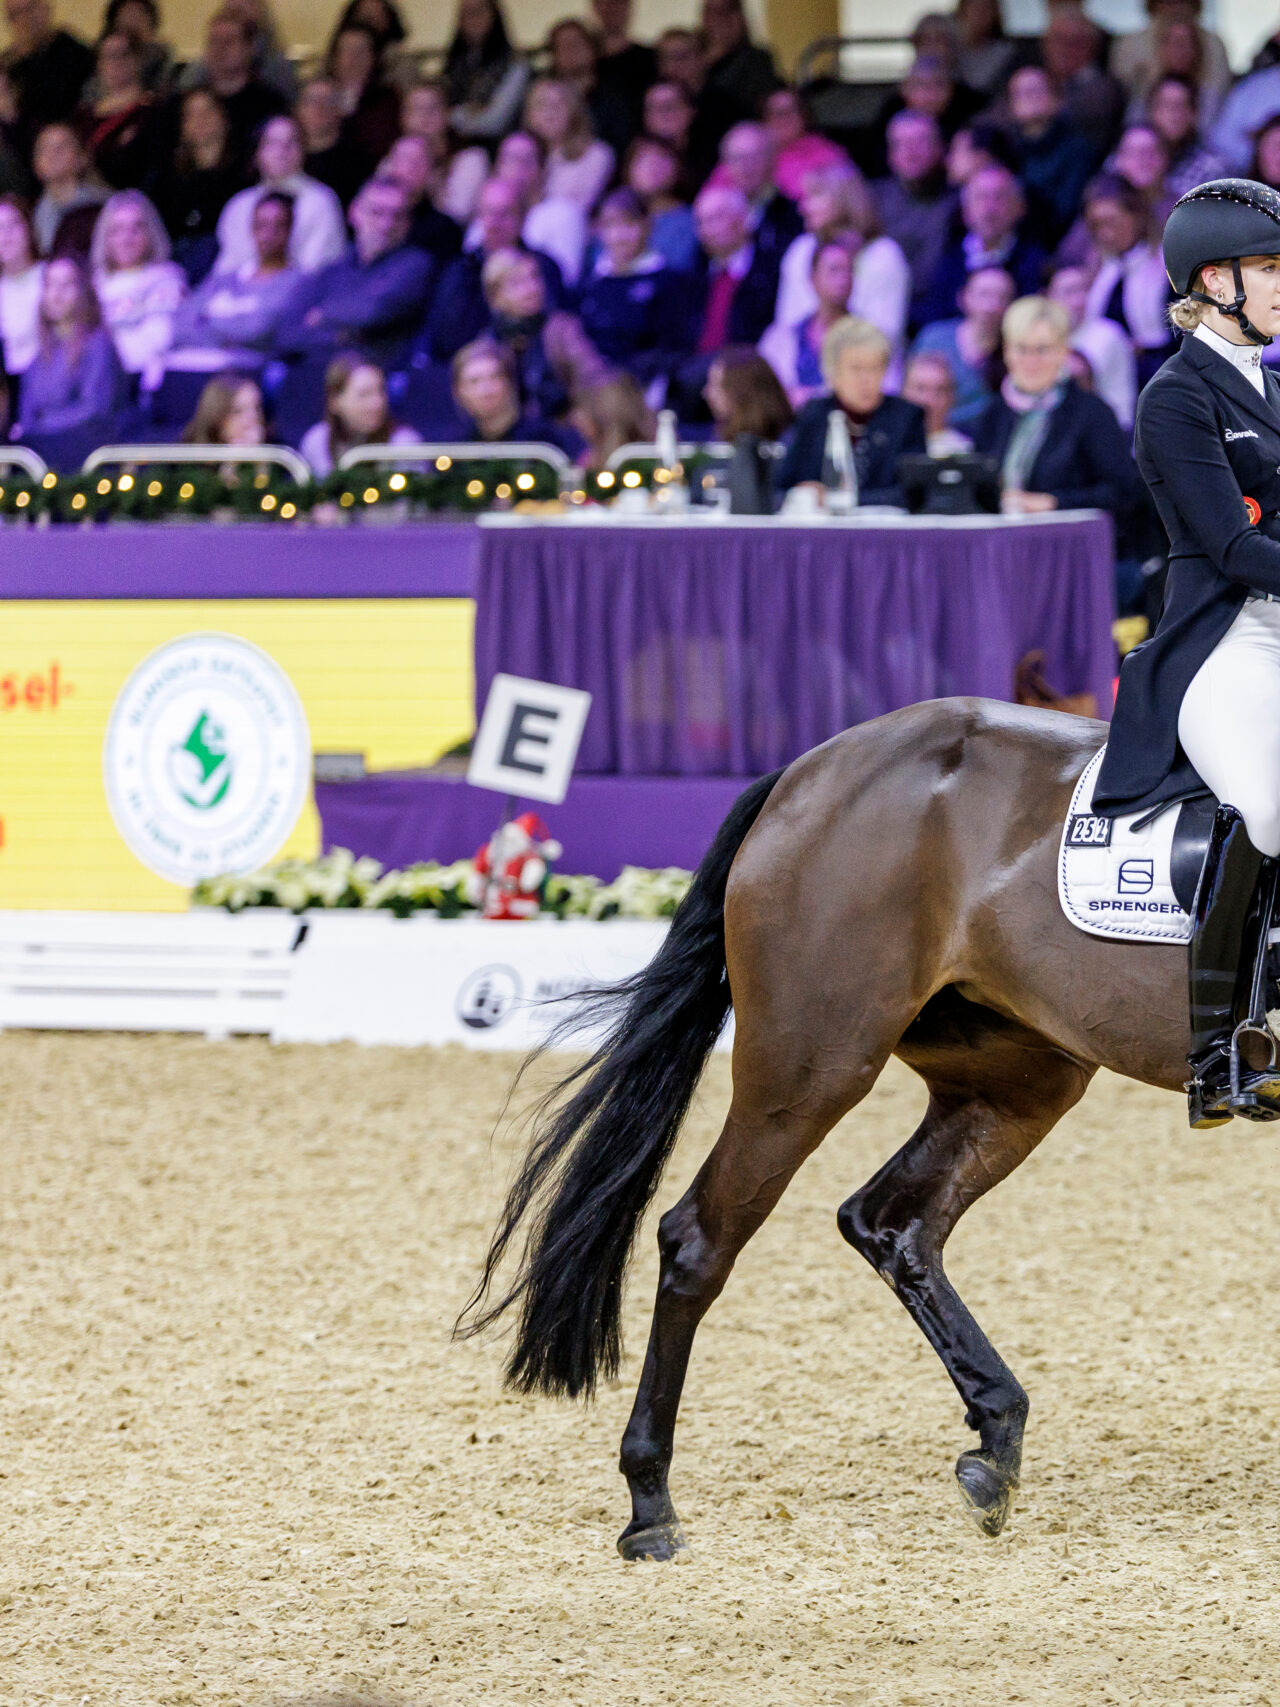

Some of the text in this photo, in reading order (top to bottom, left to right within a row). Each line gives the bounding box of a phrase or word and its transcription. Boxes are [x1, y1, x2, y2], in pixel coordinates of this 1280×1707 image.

[499, 702, 559, 775] E
[1074, 817, 1106, 840] 252
[1088, 900, 1182, 914] SPRENGER
